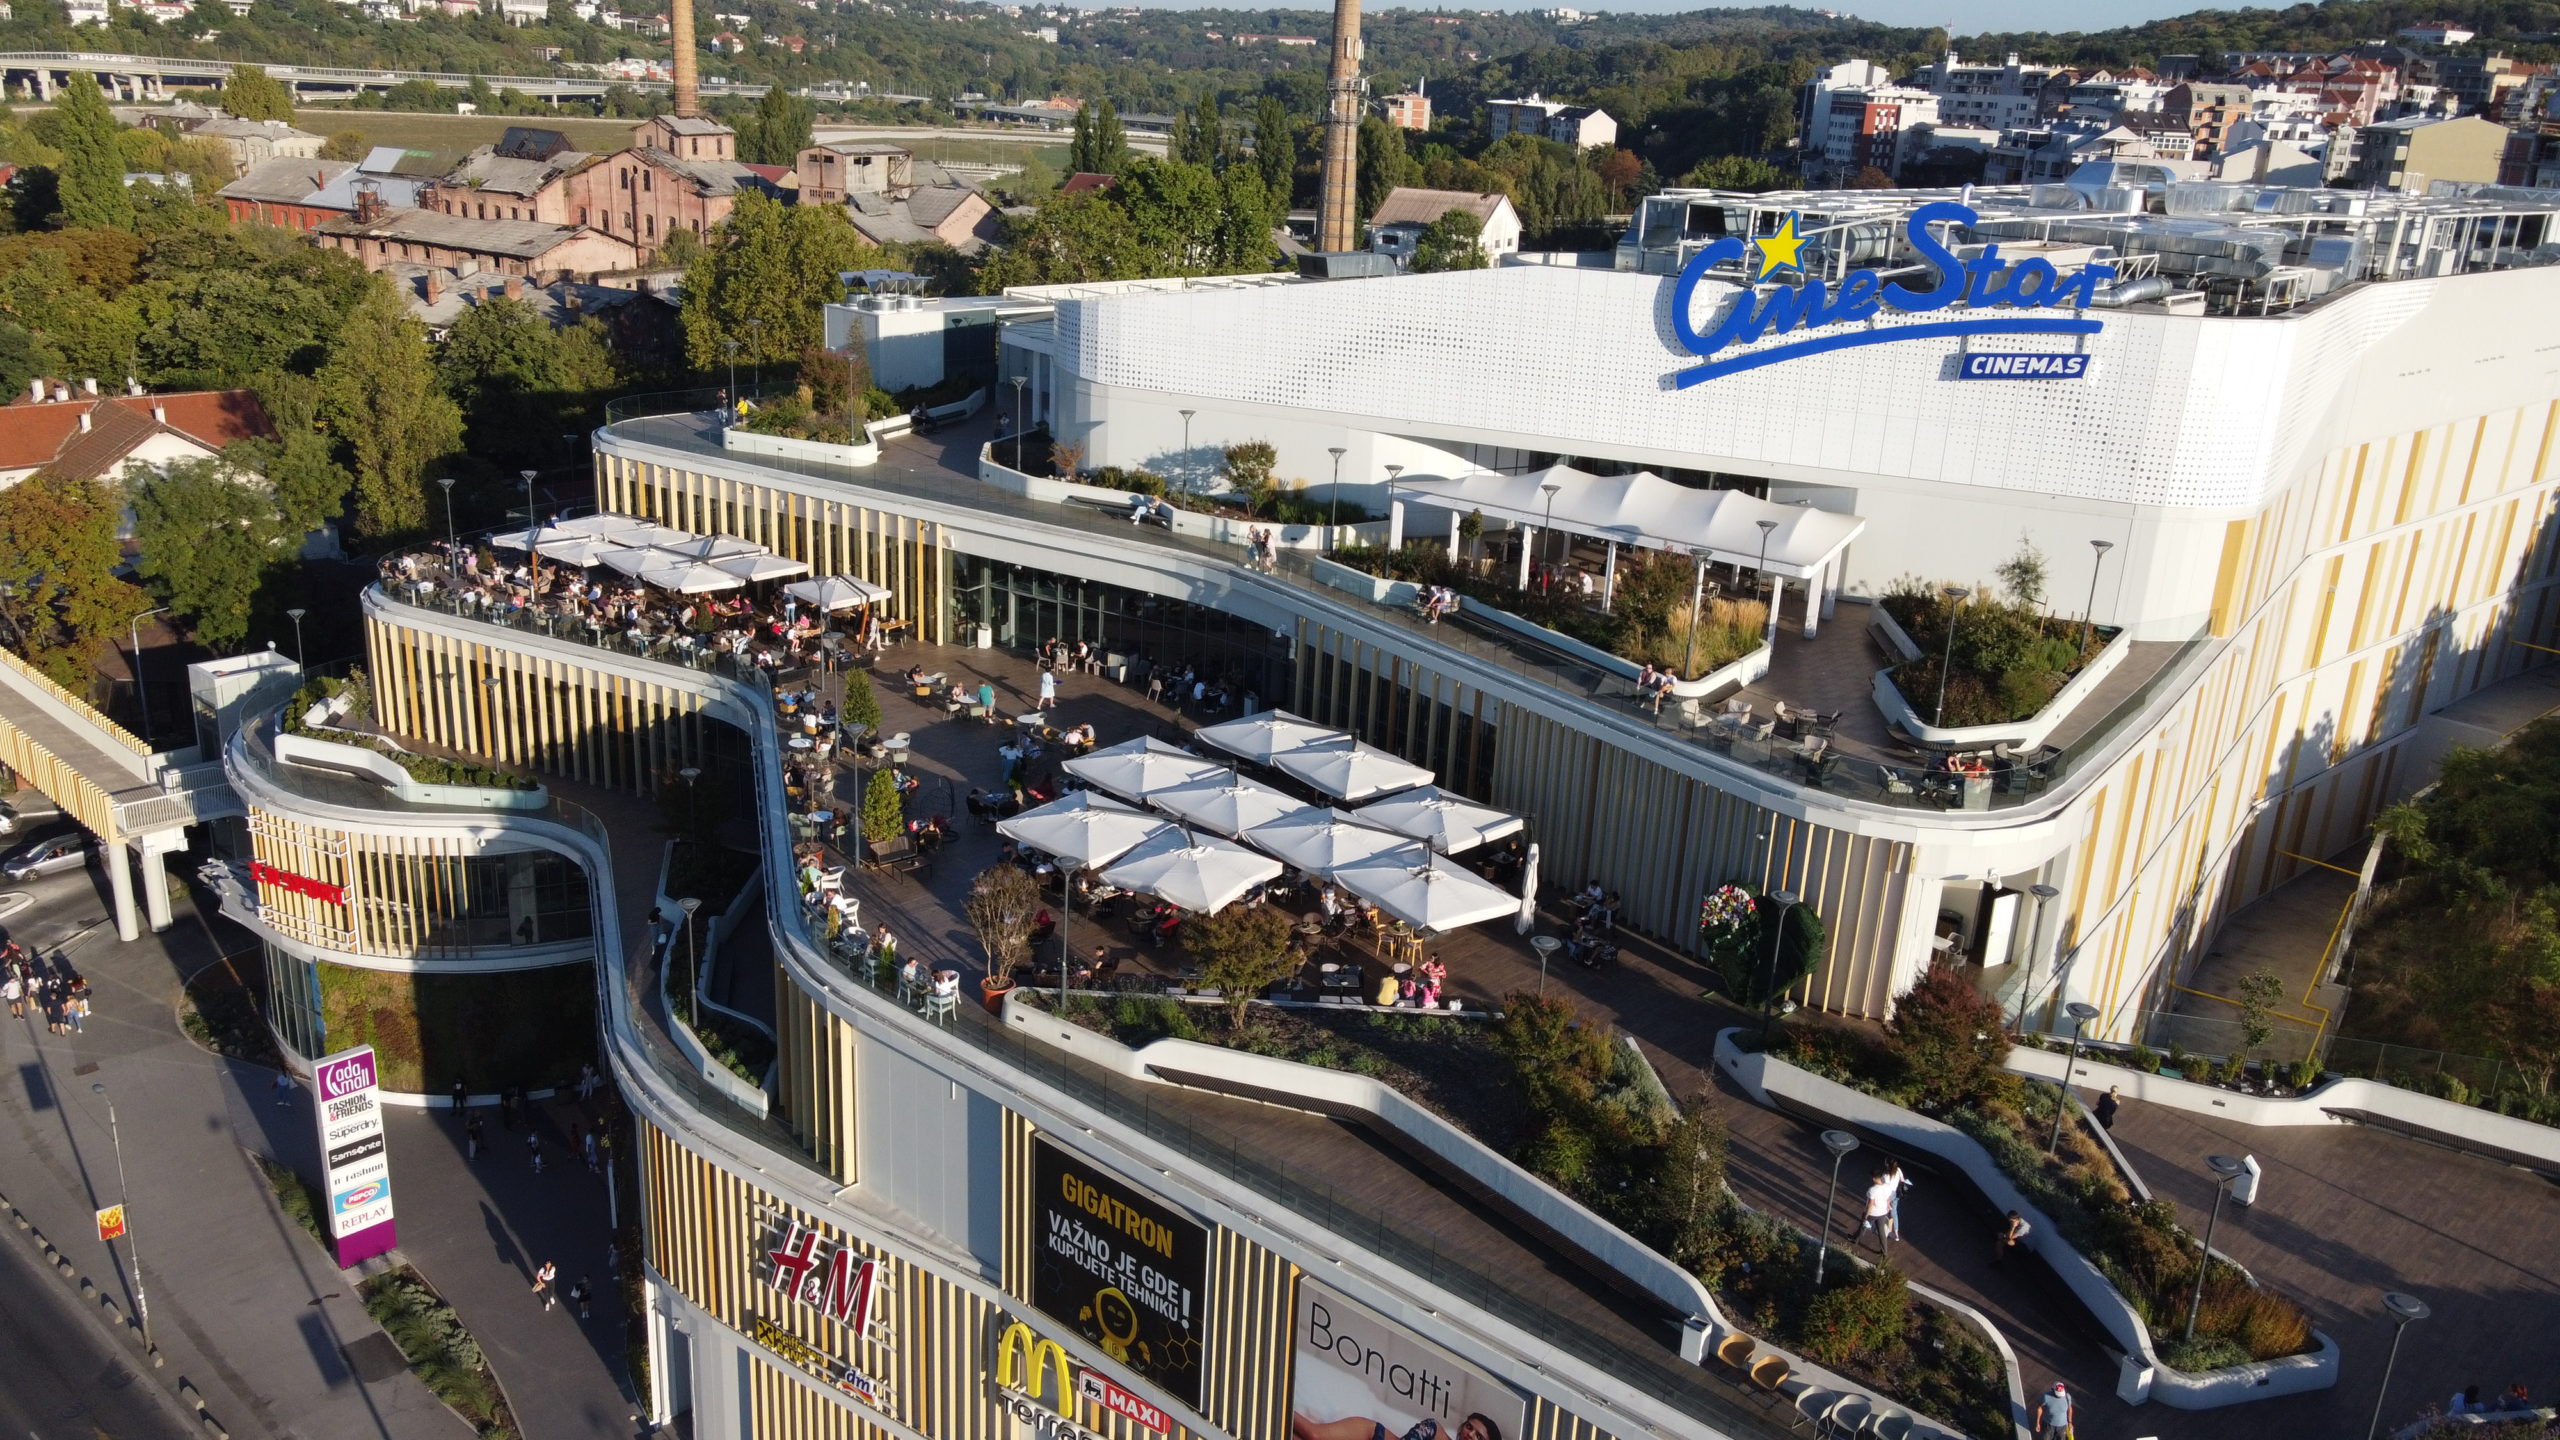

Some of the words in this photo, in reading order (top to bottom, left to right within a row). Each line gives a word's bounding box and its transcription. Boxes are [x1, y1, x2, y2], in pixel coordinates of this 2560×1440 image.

[1672, 201, 2116, 355] CineStar
[1971, 356, 2083, 375] CINEMAS
[328, 1093, 367, 1113] FASHION
[331, 1140, 382, 1163] Samsonite
[348, 1187, 376, 1204] PEPCO
[341, 1204, 388, 1231] REPLAY
[1062, 1173, 1173, 1259] GIGATRON
[1049, 1209, 1110, 1263] VAŽNO
[1115, 1251, 1137, 1279] JE
[1141, 1265, 1179, 1304] GDE
[1049, 1233, 1116, 1286] KUPUJETE
[768, 1220, 879, 1340] H&M
[777, 1344, 806, 1366] BANK
[1310, 1301, 1451, 1419] Bonatti
[846, 1369, 871, 1393] dm
[1109, 1390, 1160, 1428] MAXI
